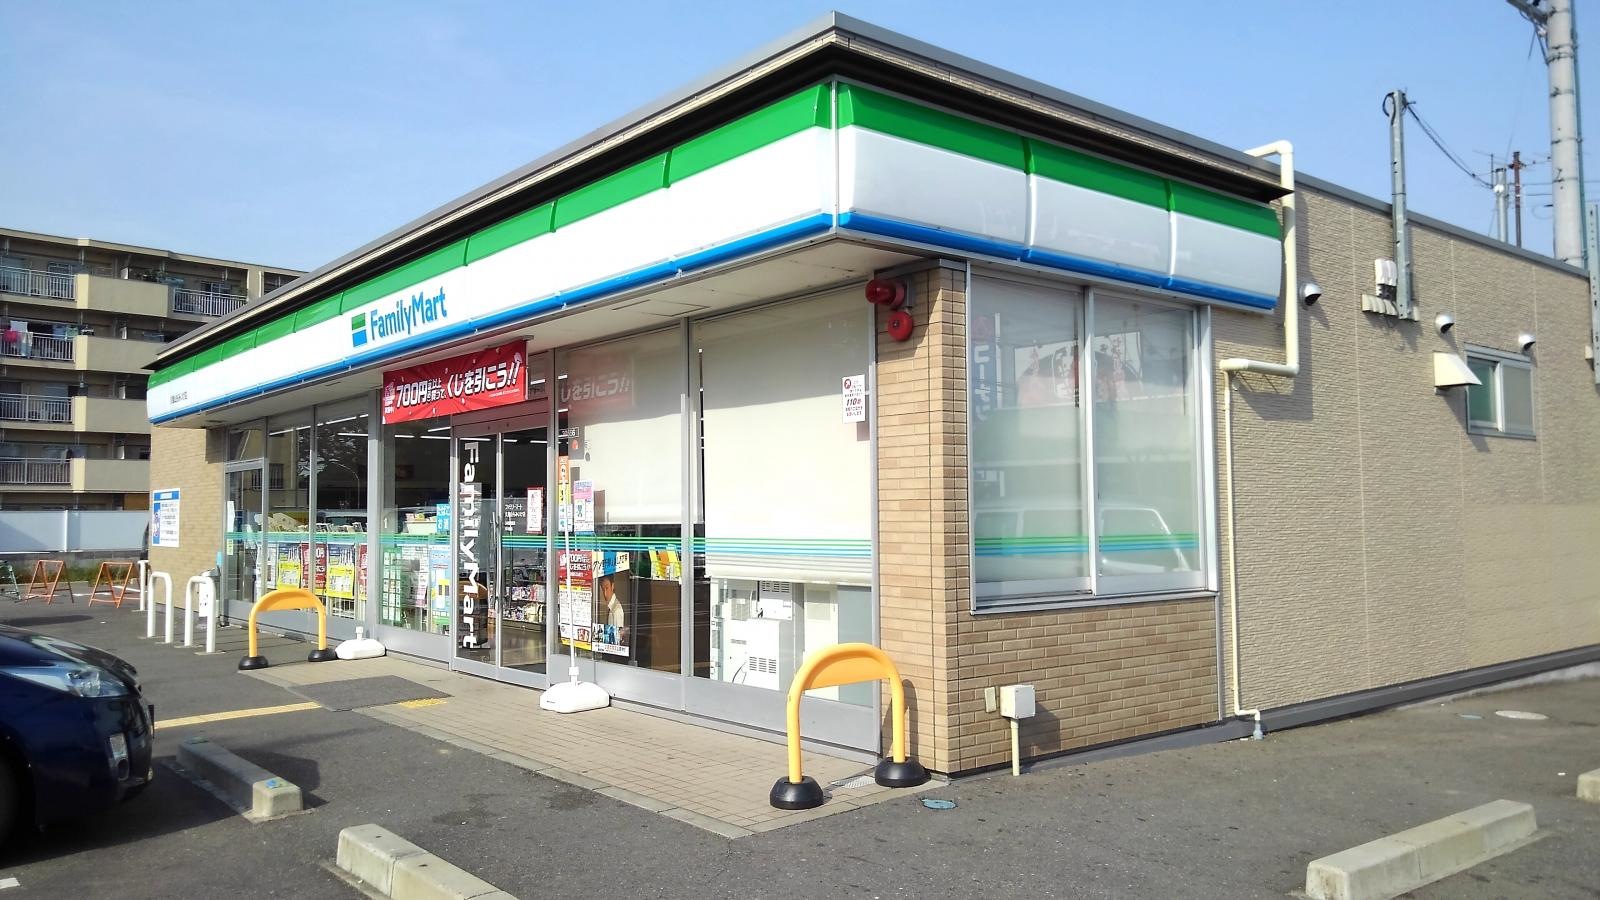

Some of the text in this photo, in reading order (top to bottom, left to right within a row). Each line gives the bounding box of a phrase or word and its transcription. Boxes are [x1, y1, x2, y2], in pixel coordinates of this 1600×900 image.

[370, 286, 447, 340] FamilyMart
[396, 378, 428, 408] 700円
[459, 441, 480, 648] FamilyMart
